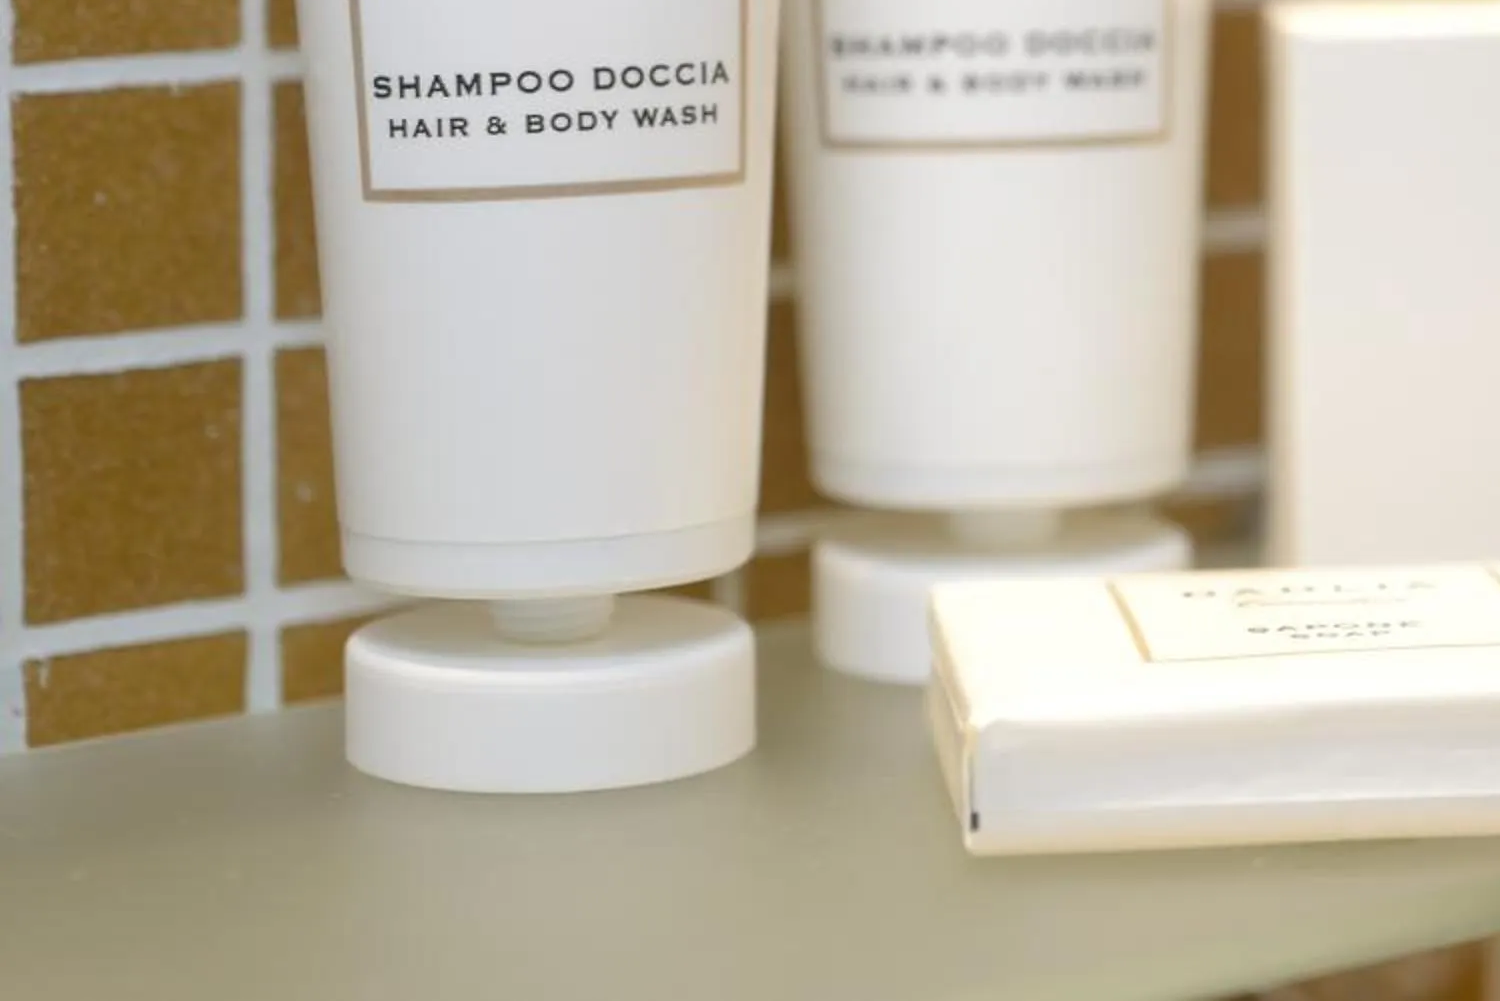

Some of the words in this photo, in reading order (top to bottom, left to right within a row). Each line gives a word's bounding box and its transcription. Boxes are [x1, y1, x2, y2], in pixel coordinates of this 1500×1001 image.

[372, 68, 575, 100] SHAMPOO
[592, 59, 731, 92] DOCCIA
[388, 116, 470, 139] HAIR
[486, 115, 508, 136] &
[525, 108, 620, 135] BODY
[632, 103, 719, 129] WASH
